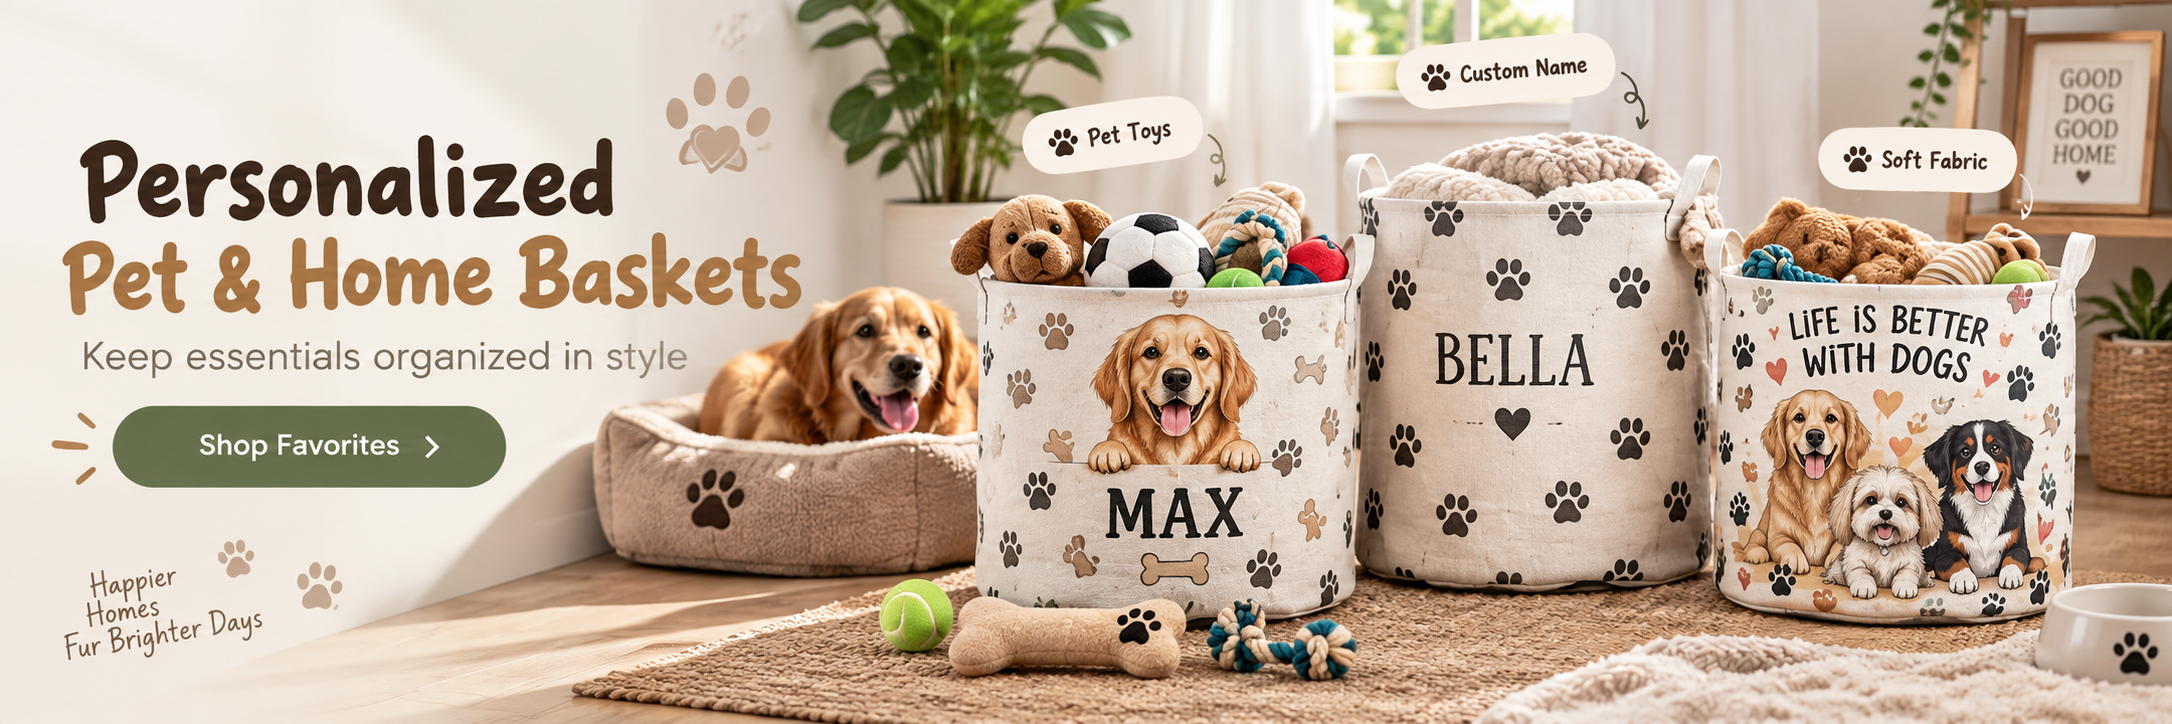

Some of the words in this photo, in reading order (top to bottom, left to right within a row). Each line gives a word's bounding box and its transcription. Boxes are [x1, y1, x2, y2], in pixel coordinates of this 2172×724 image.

[2060, 68, 2122, 88] GOOD
[2064, 94, 2114, 114] DOG
[2055, 119, 2118, 139] GOOD
[2053, 144, 2115, 164] HOME
[1891, 305, 1989, 347] BETTER
[1435, 333, 1594, 386] BELLA
[1891, 343, 1970, 382] DOGS
[1106, 487, 1243, 539] MAX
